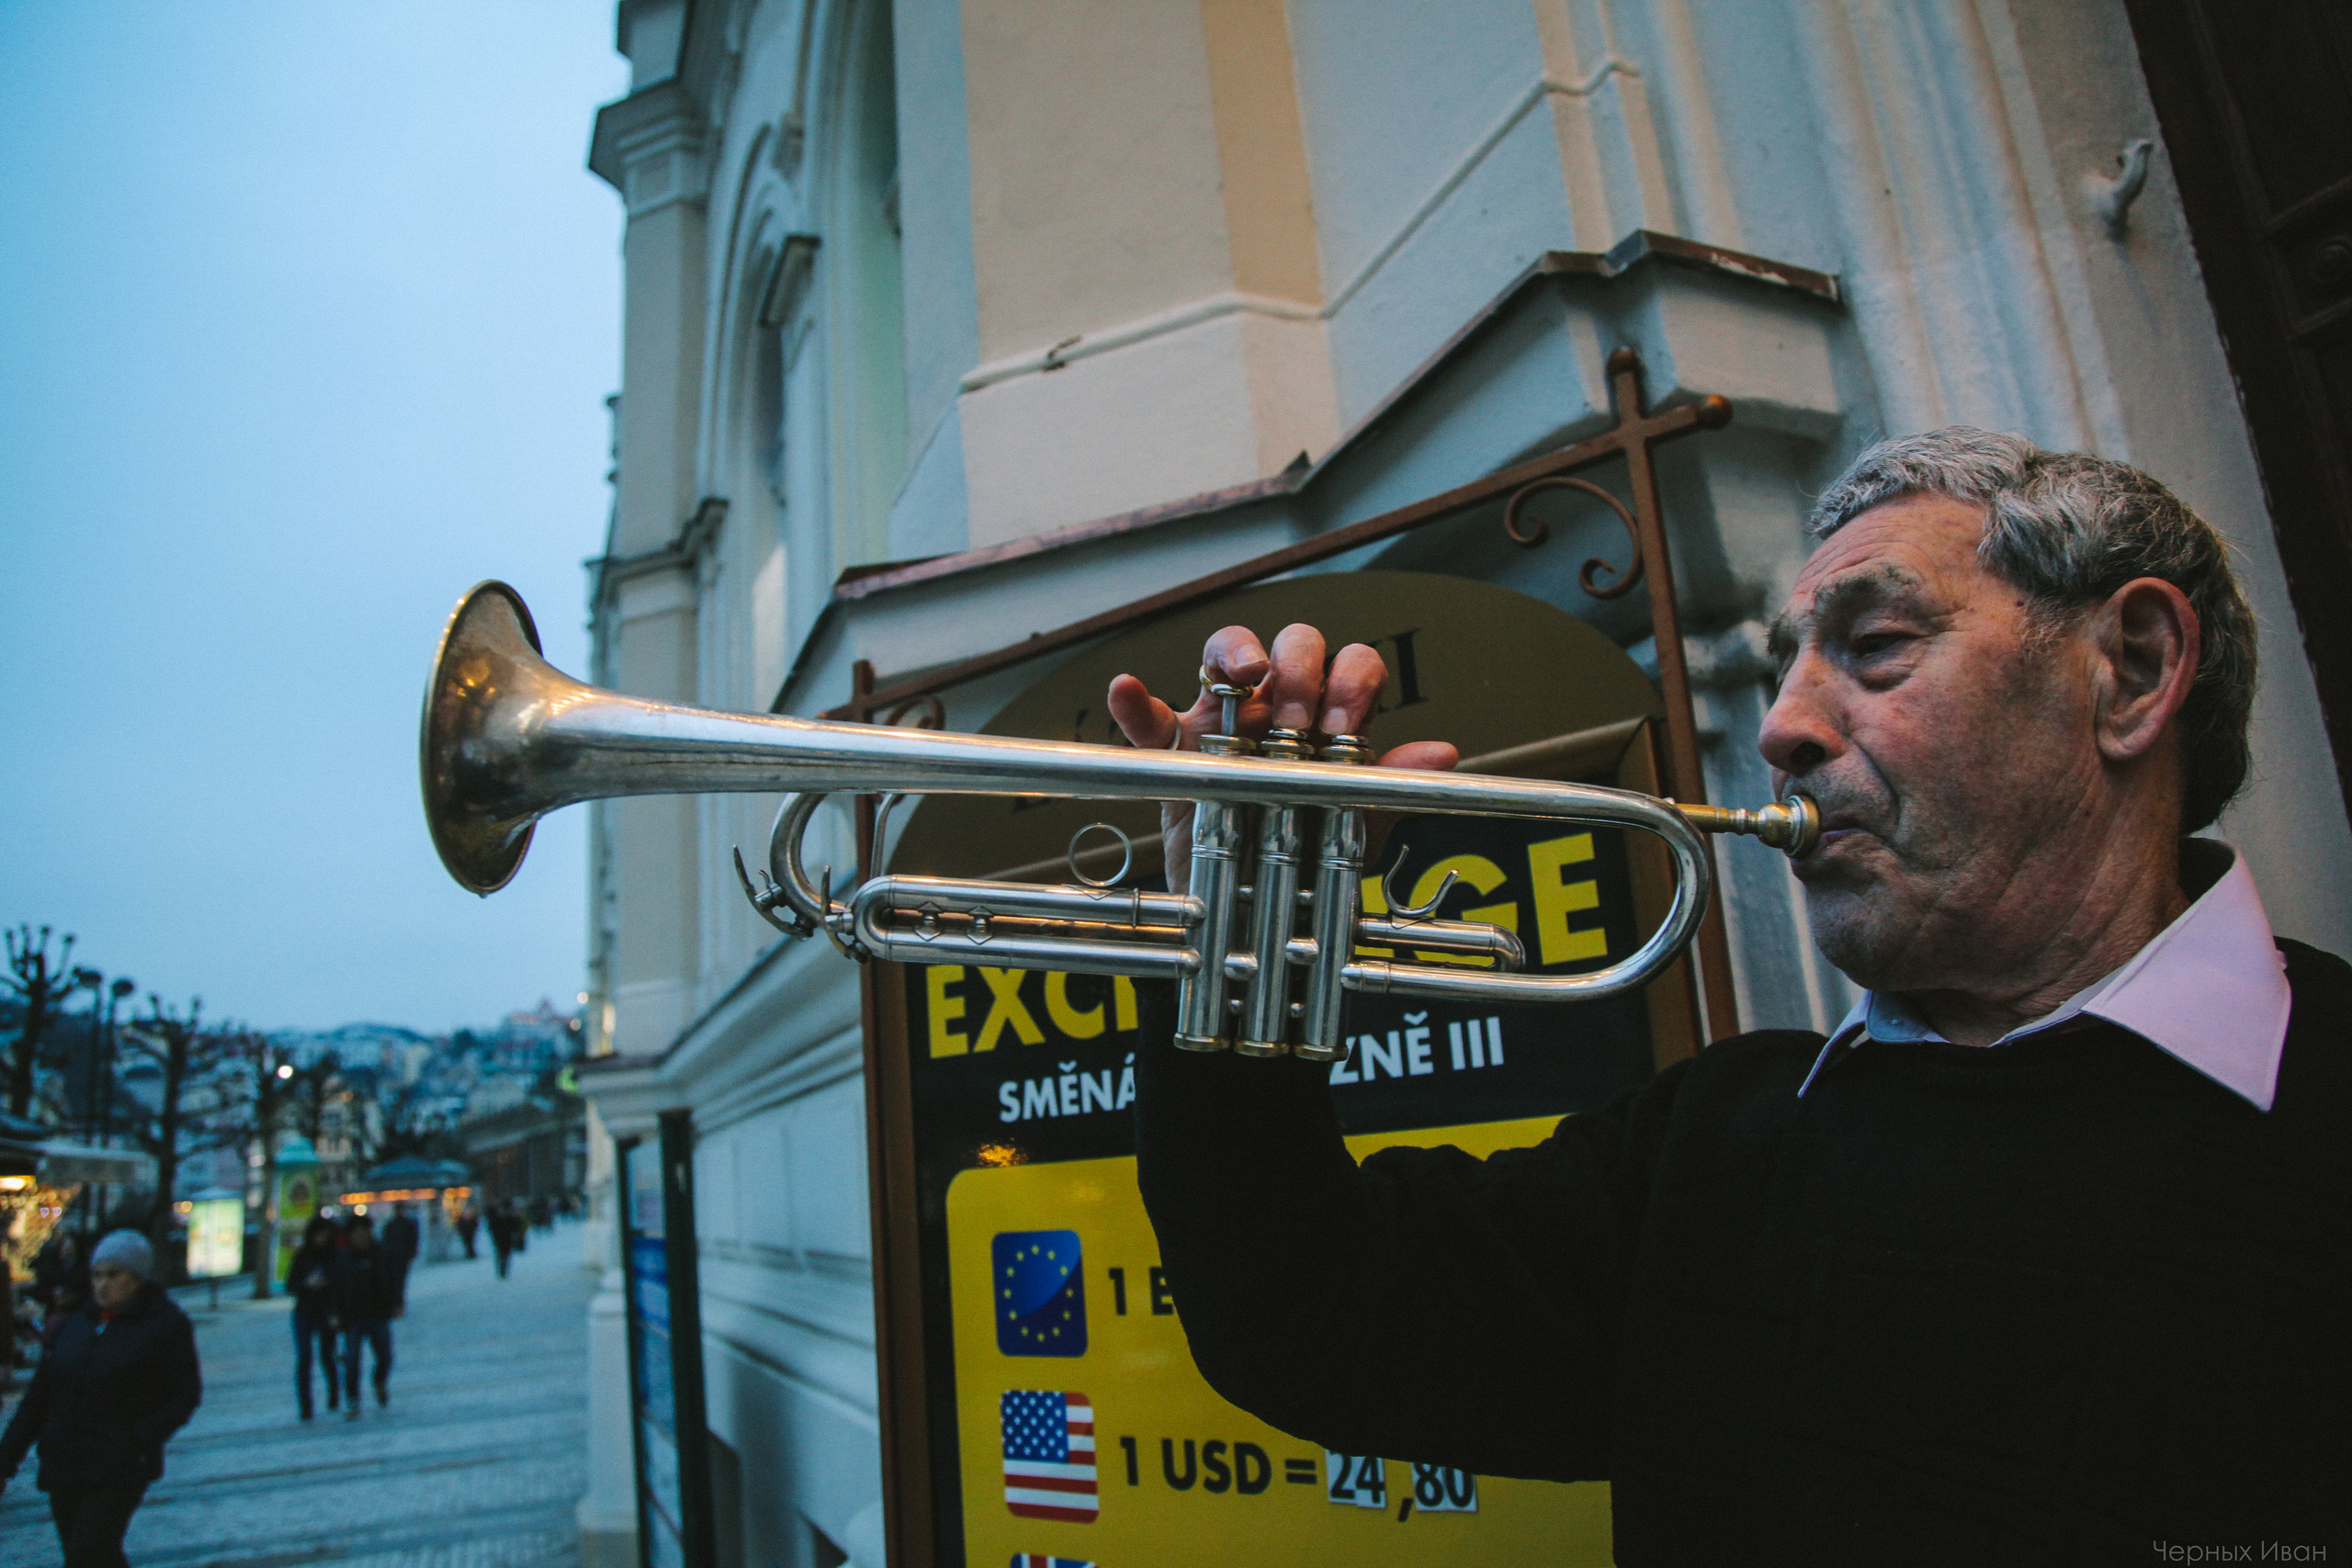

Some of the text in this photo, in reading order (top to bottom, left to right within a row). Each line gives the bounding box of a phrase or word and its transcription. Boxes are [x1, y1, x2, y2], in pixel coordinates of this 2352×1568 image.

[998, 1010, 1504, 1122] SMĚNÁ ZNĚ III
[1108, 1267, 1127, 1316] 1
[1119, 1436, 1139, 1486] 1
[1160, 1437, 1272, 1495] USD
